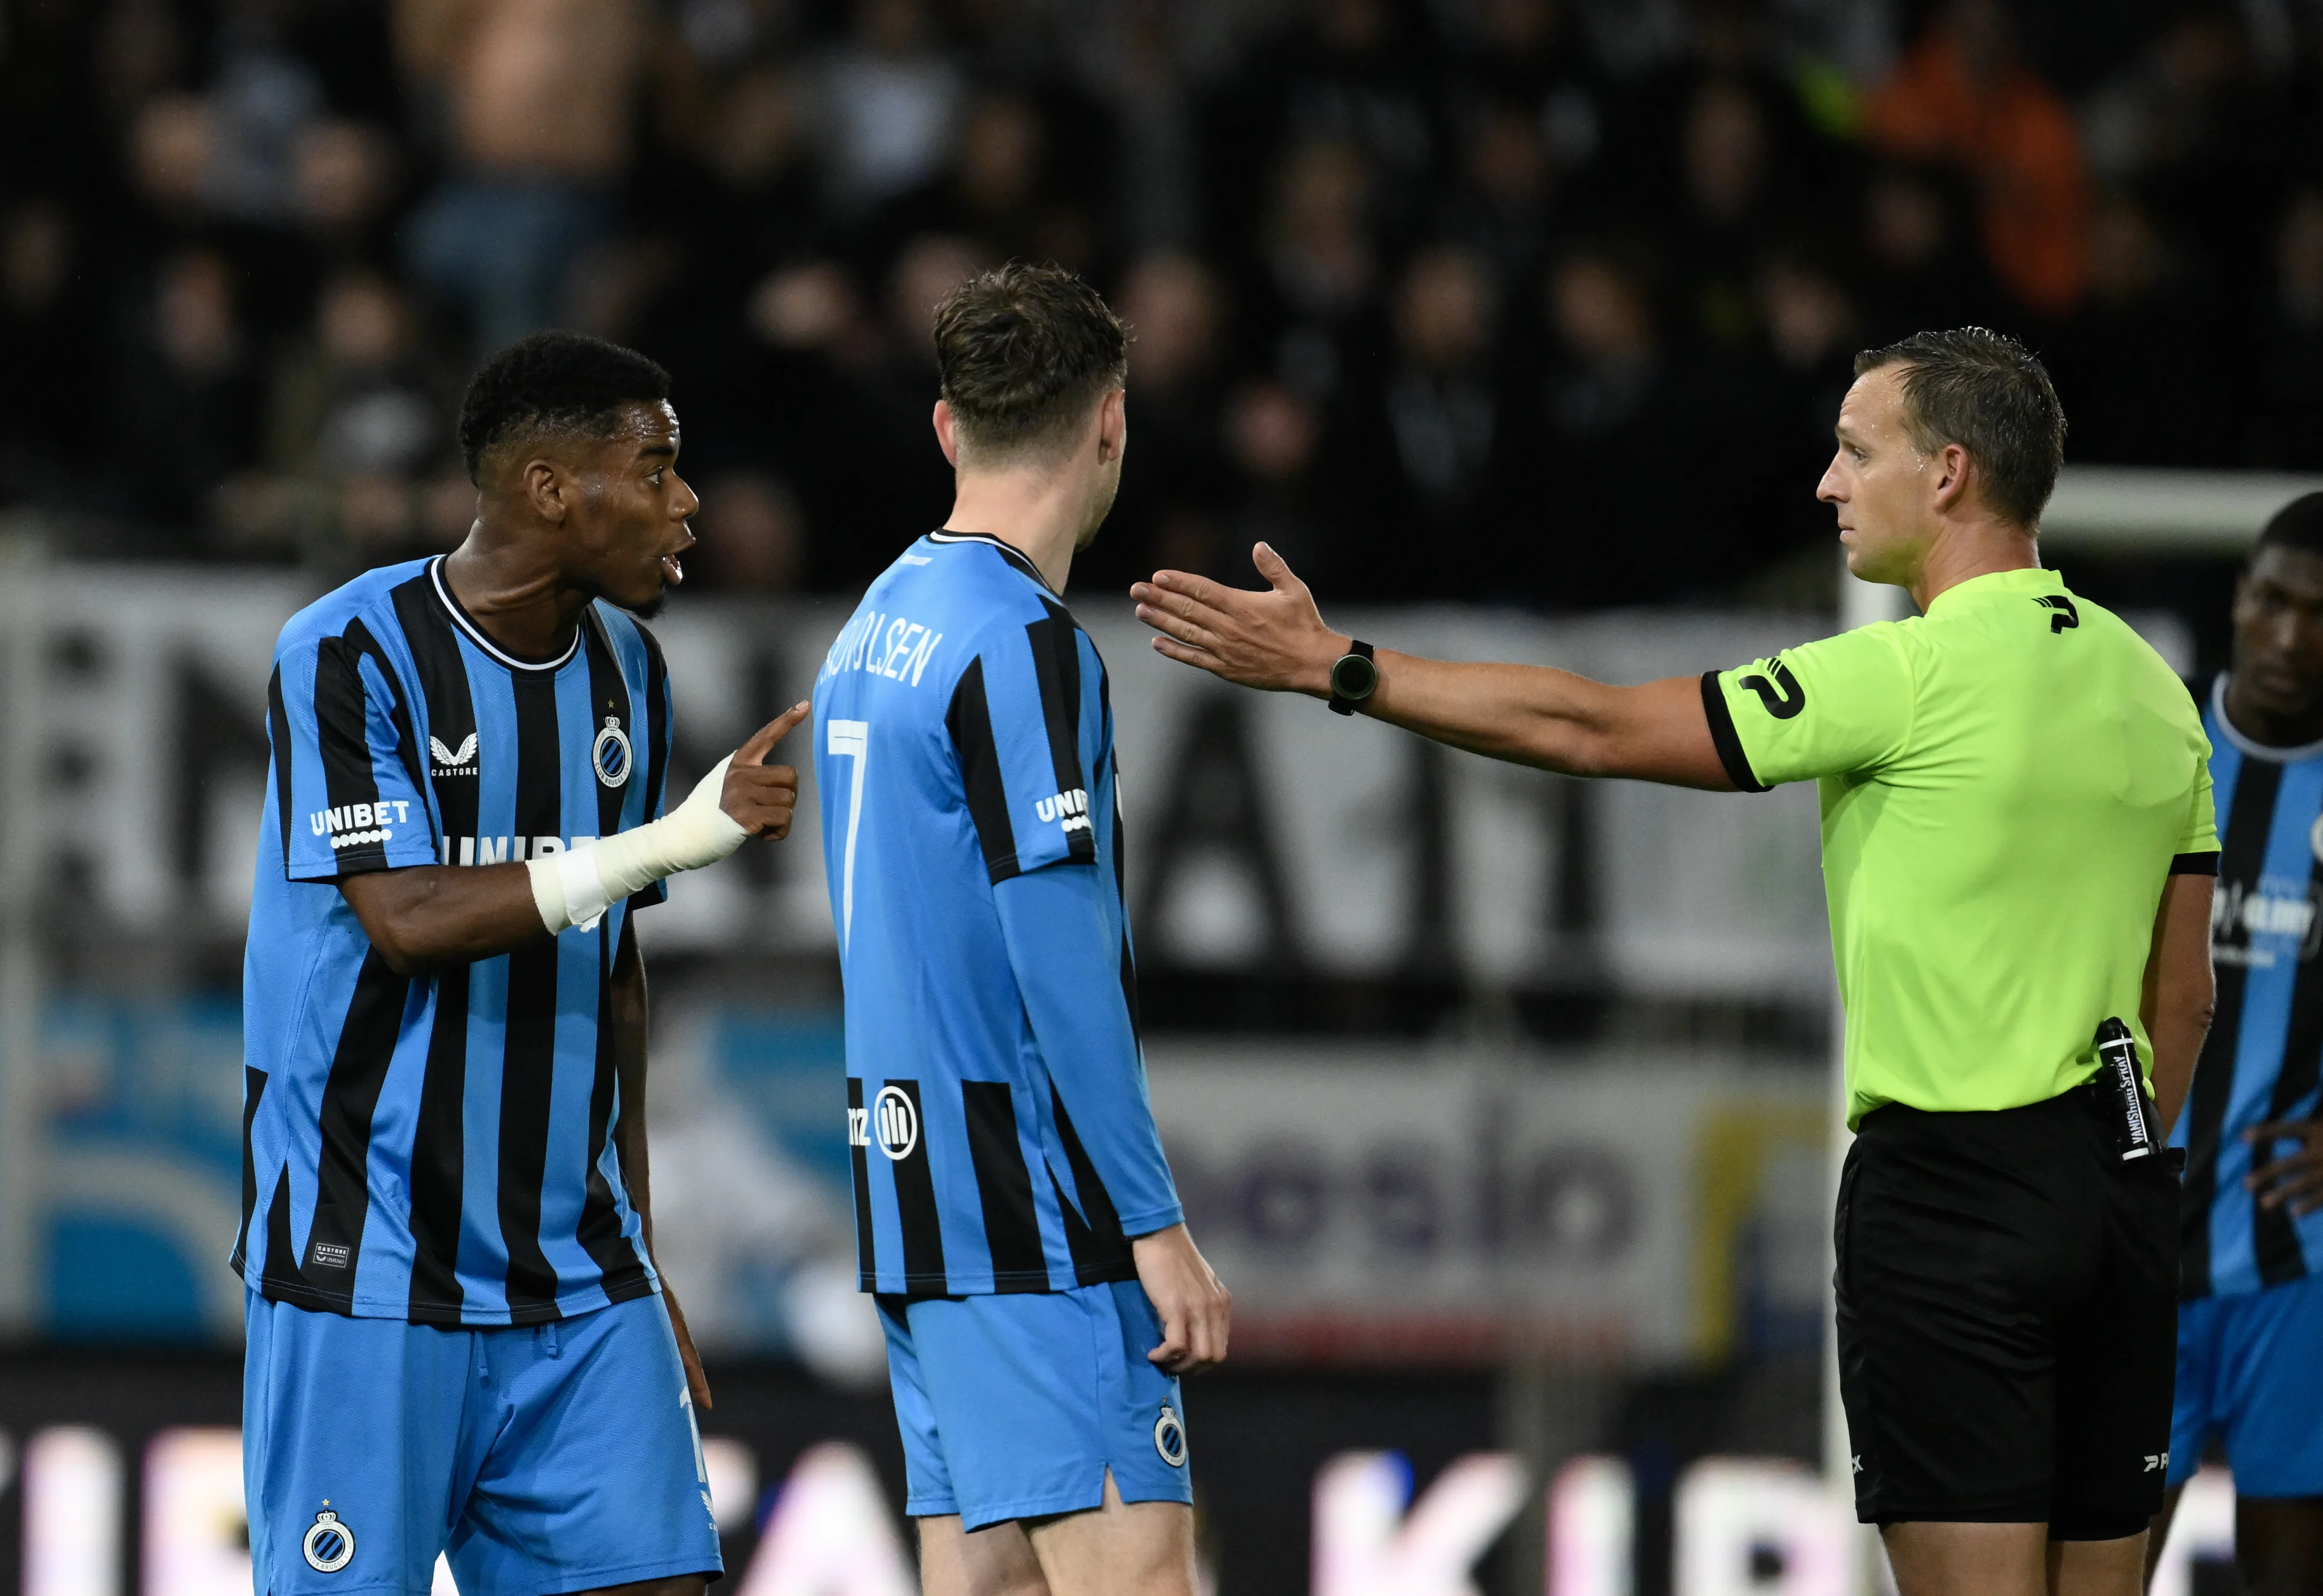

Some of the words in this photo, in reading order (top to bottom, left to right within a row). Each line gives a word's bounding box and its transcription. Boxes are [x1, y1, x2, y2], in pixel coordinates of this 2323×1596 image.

[431, 767, 478, 777] CASTORE
[595, 762, 605, 779] CLUB
[605, 775, 624, 786] BRUGGE
[310, 800, 409, 836] UNIBET
[828, 720, 868, 957] 7
[318, 1246, 347, 1255] CASTORE
[307, 1554, 319, 1567] CLUB
[321, 1559, 345, 1570] BRUGGE
